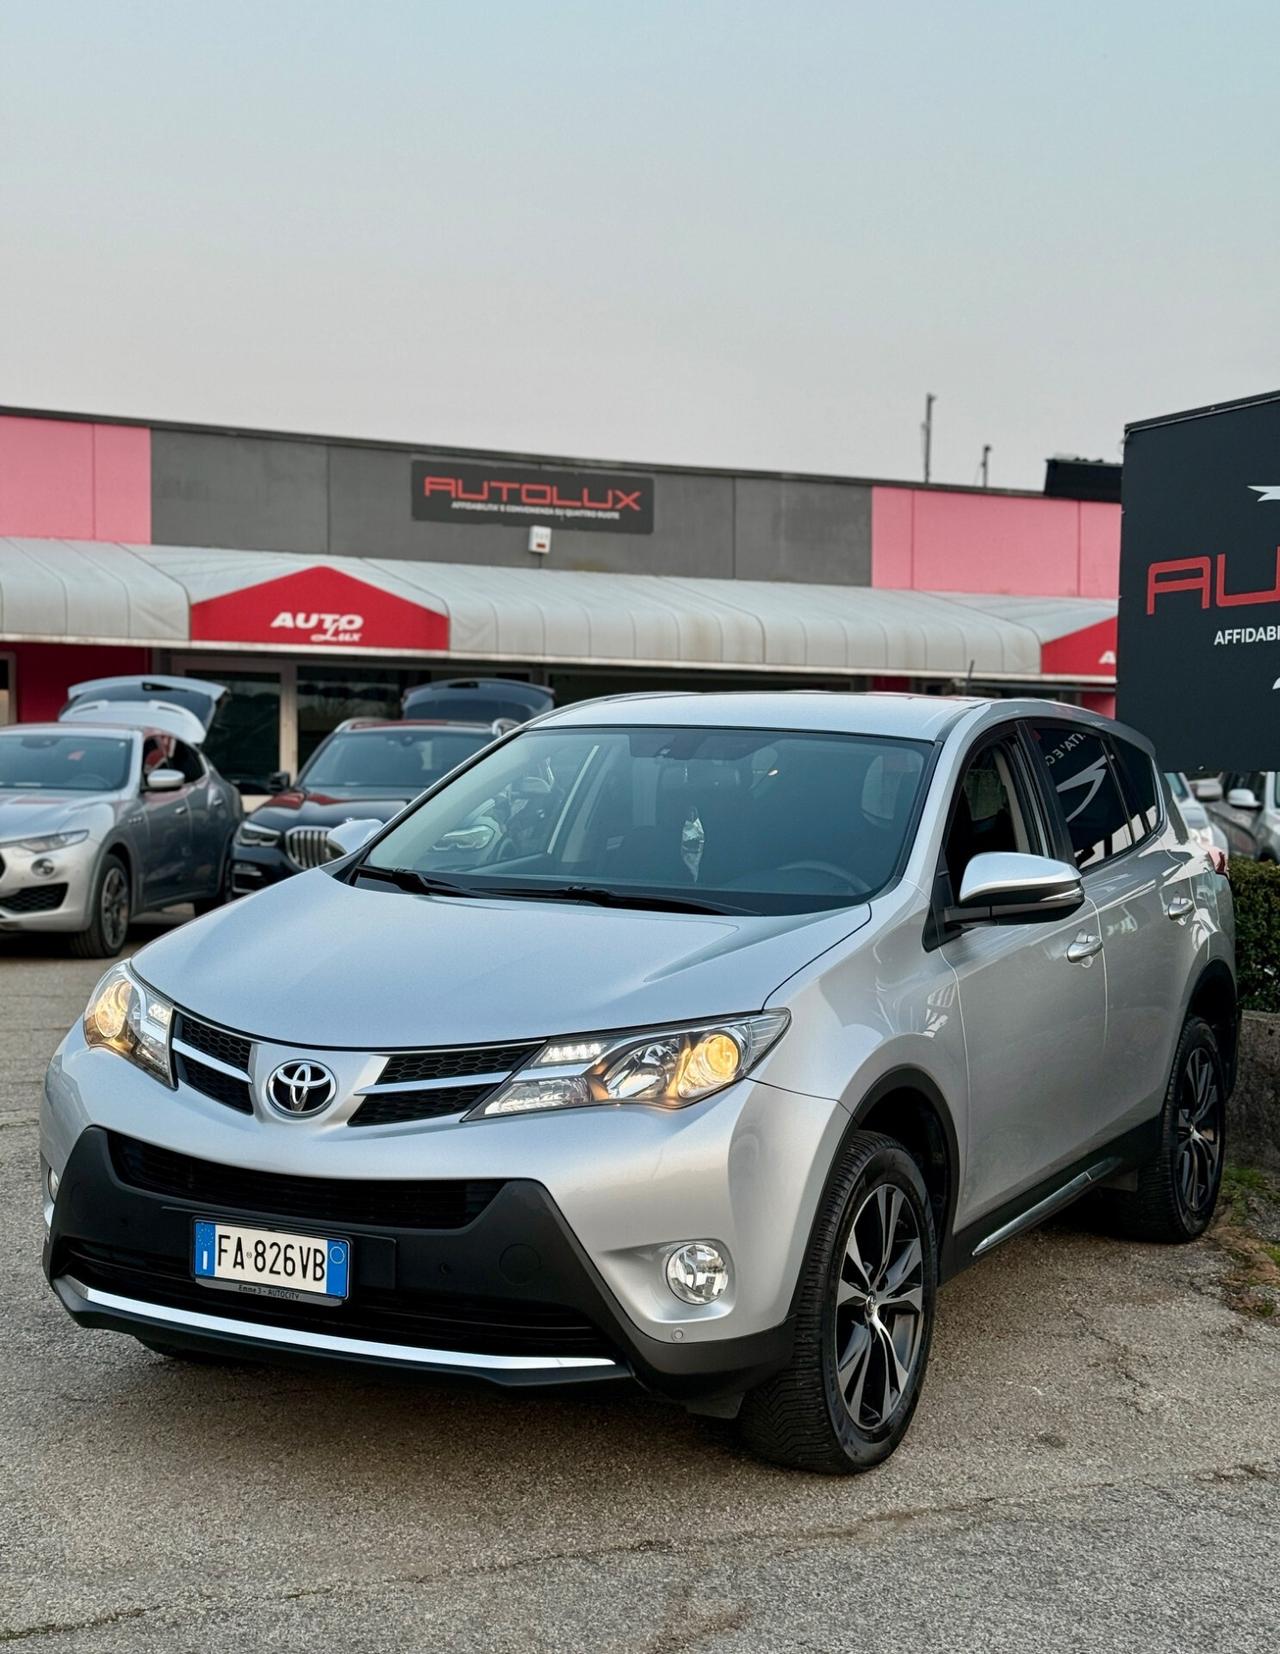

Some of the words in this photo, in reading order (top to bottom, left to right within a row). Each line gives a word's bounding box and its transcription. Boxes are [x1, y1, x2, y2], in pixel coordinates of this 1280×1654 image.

[424, 476, 641, 511] AUTOLUX
[270, 611, 364, 631] AUTO
[218, 1234, 244, 1269] FA
[254, 1239, 325, 1281] 826VB
[268, 1289, 300, 1300] AUTOCITY
